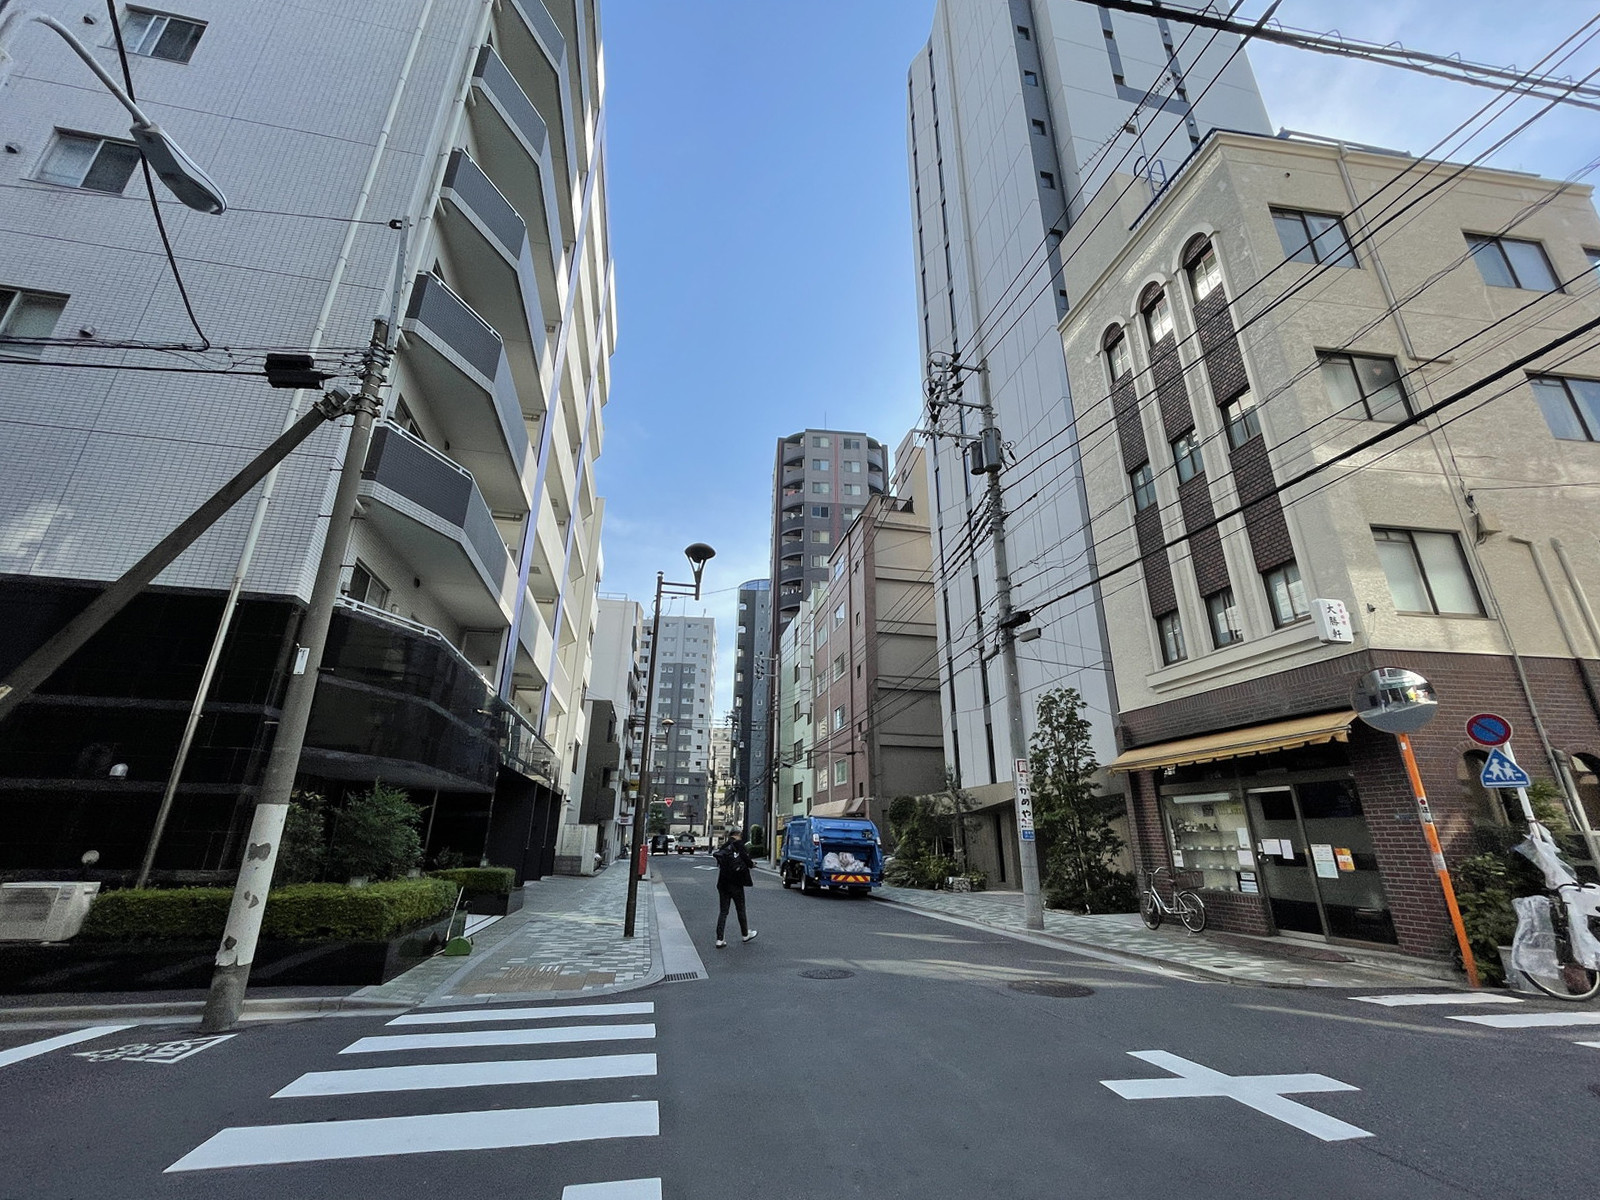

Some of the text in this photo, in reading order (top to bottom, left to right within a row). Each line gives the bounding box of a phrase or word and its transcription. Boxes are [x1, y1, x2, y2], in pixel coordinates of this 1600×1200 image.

[1326, 603, 1342, 639] 大勝軒
[1019, 787, 1032, 818] かめや
